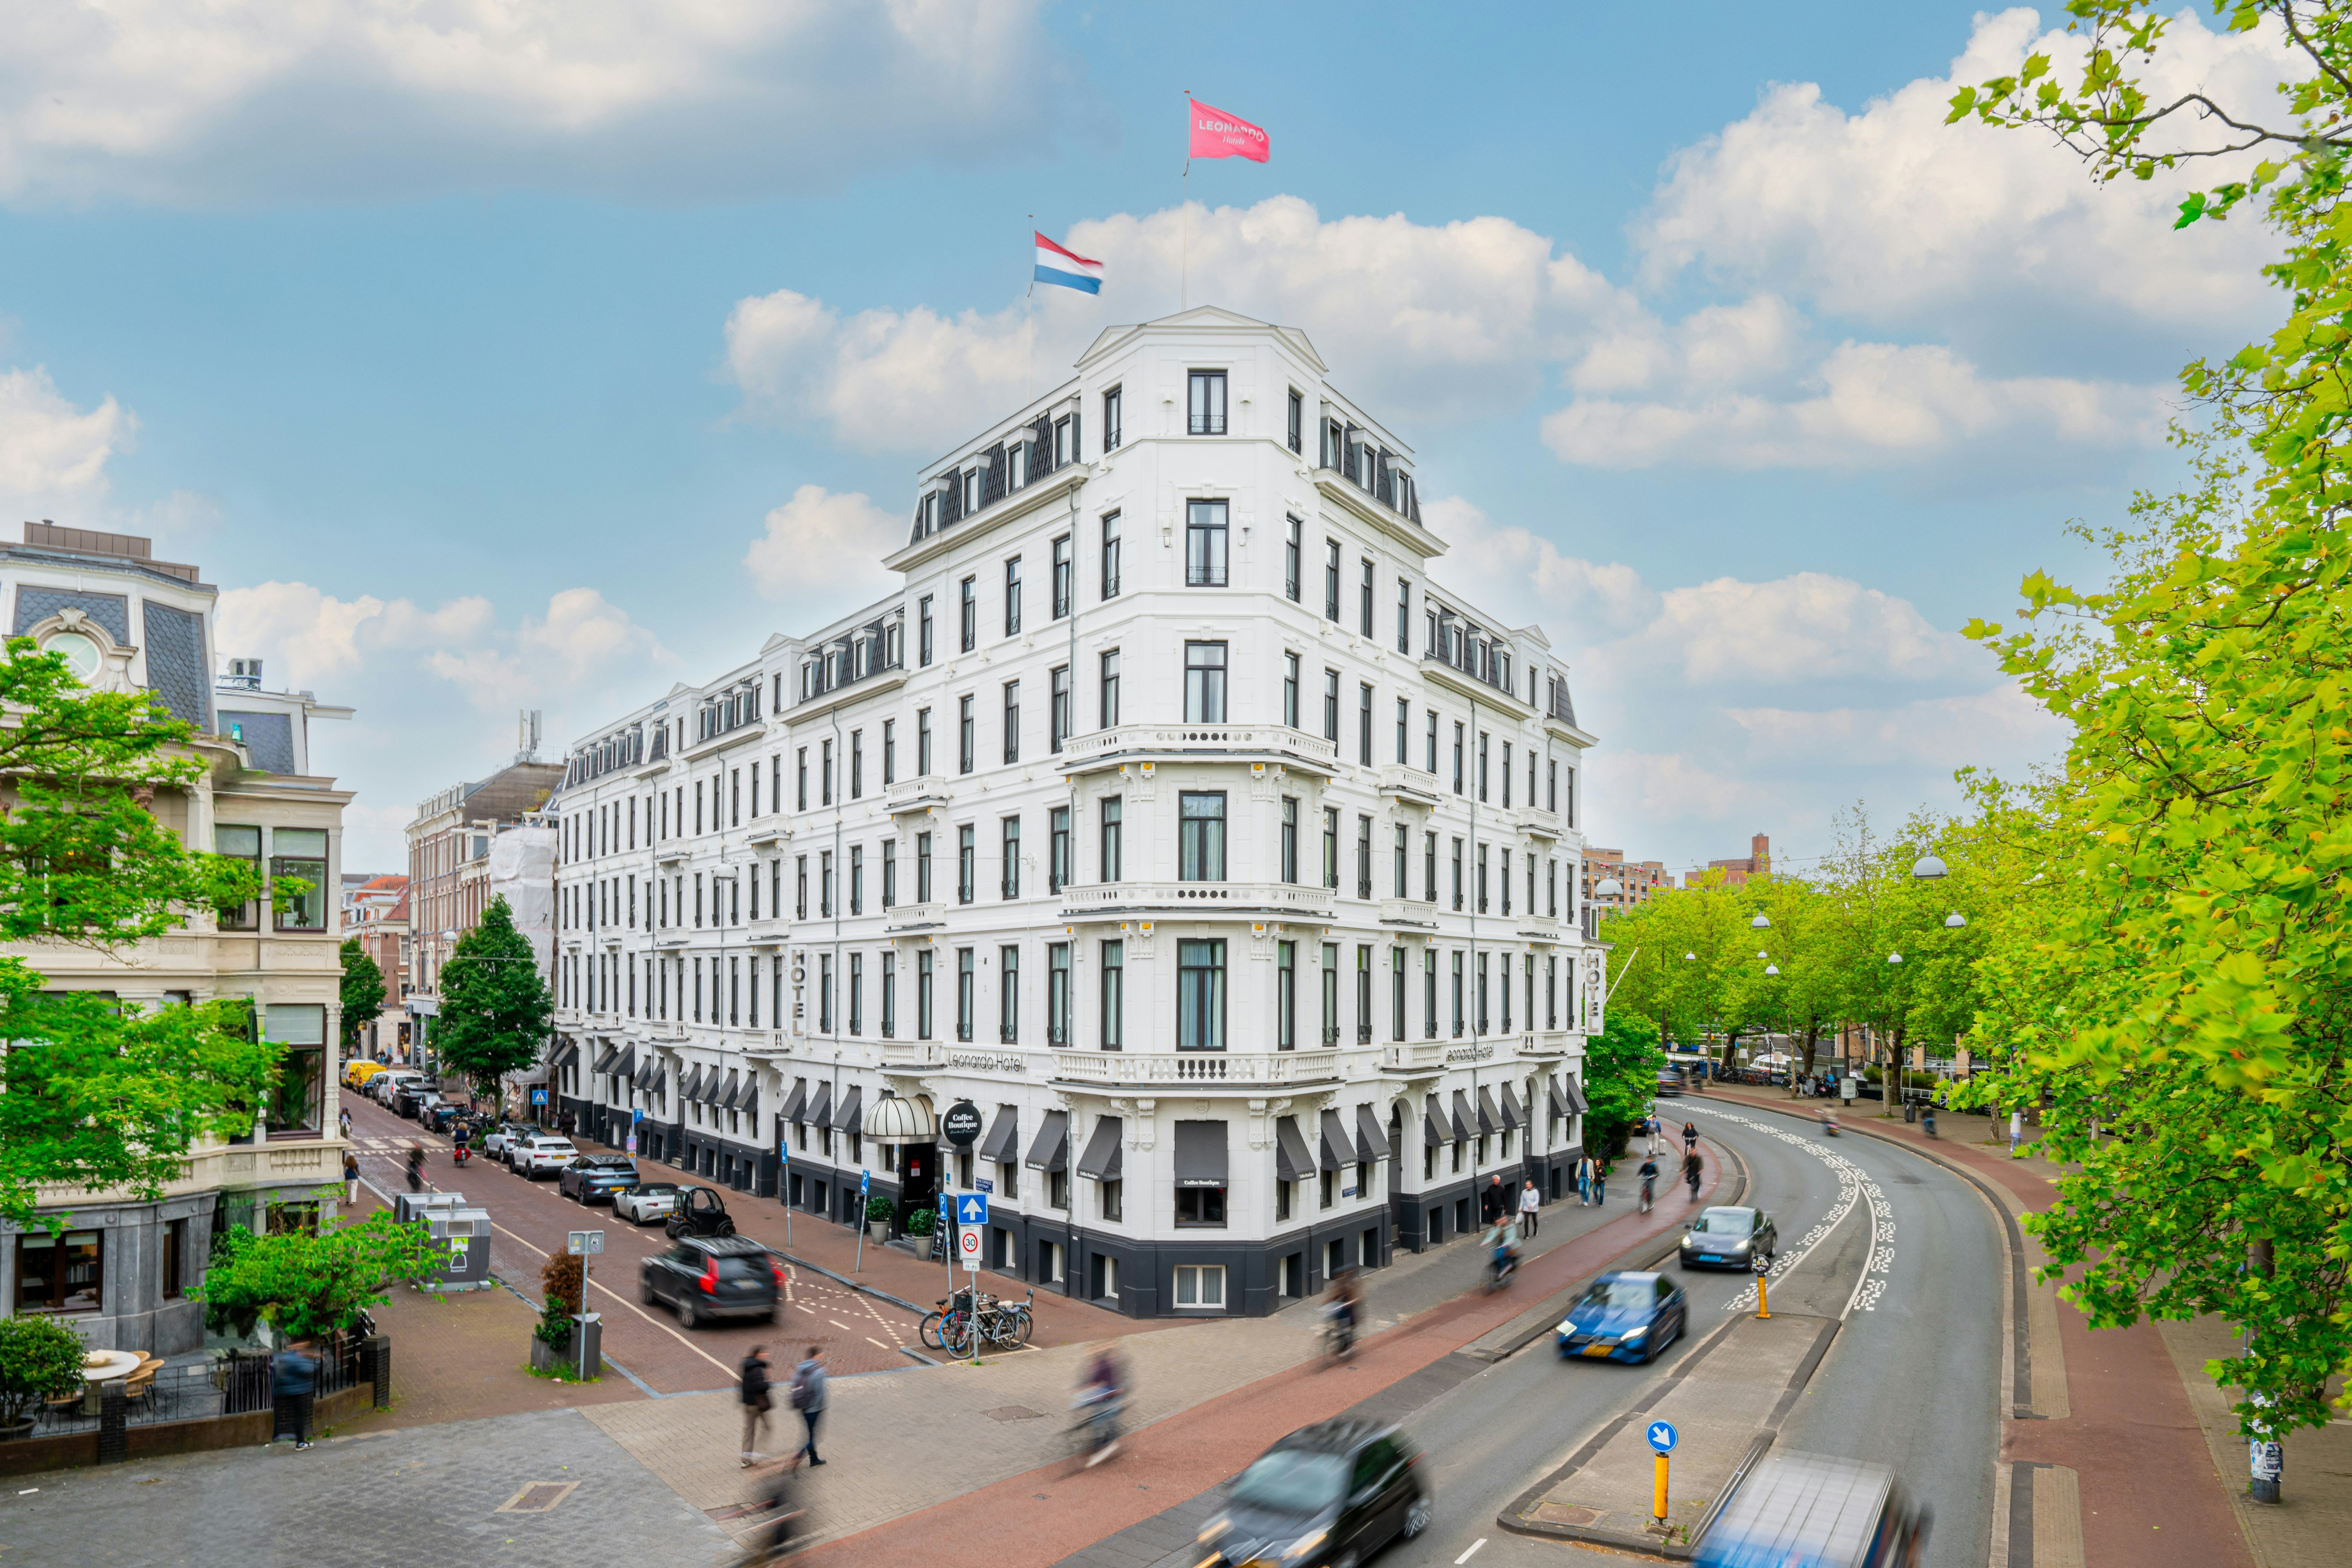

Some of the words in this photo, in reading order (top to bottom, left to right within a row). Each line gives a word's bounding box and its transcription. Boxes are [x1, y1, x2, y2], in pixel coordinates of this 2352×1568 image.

[1199, 120, 1265, 142] LEONARDO
[1222, 135, 1245, 145] Hotels
[791, 949, 805, 1036] HOTEL
[1586, 954, 1600, 1032] HOTEL
[1478, 1042, 1494, 1058] Hotel
[948, 1050, 993, 1069] Leonardo
[996, 1053, 1022, 1072] Hotel
[948, 1120, 977, 1130] Boutique
[966, 1238, 975, 1246] 30
